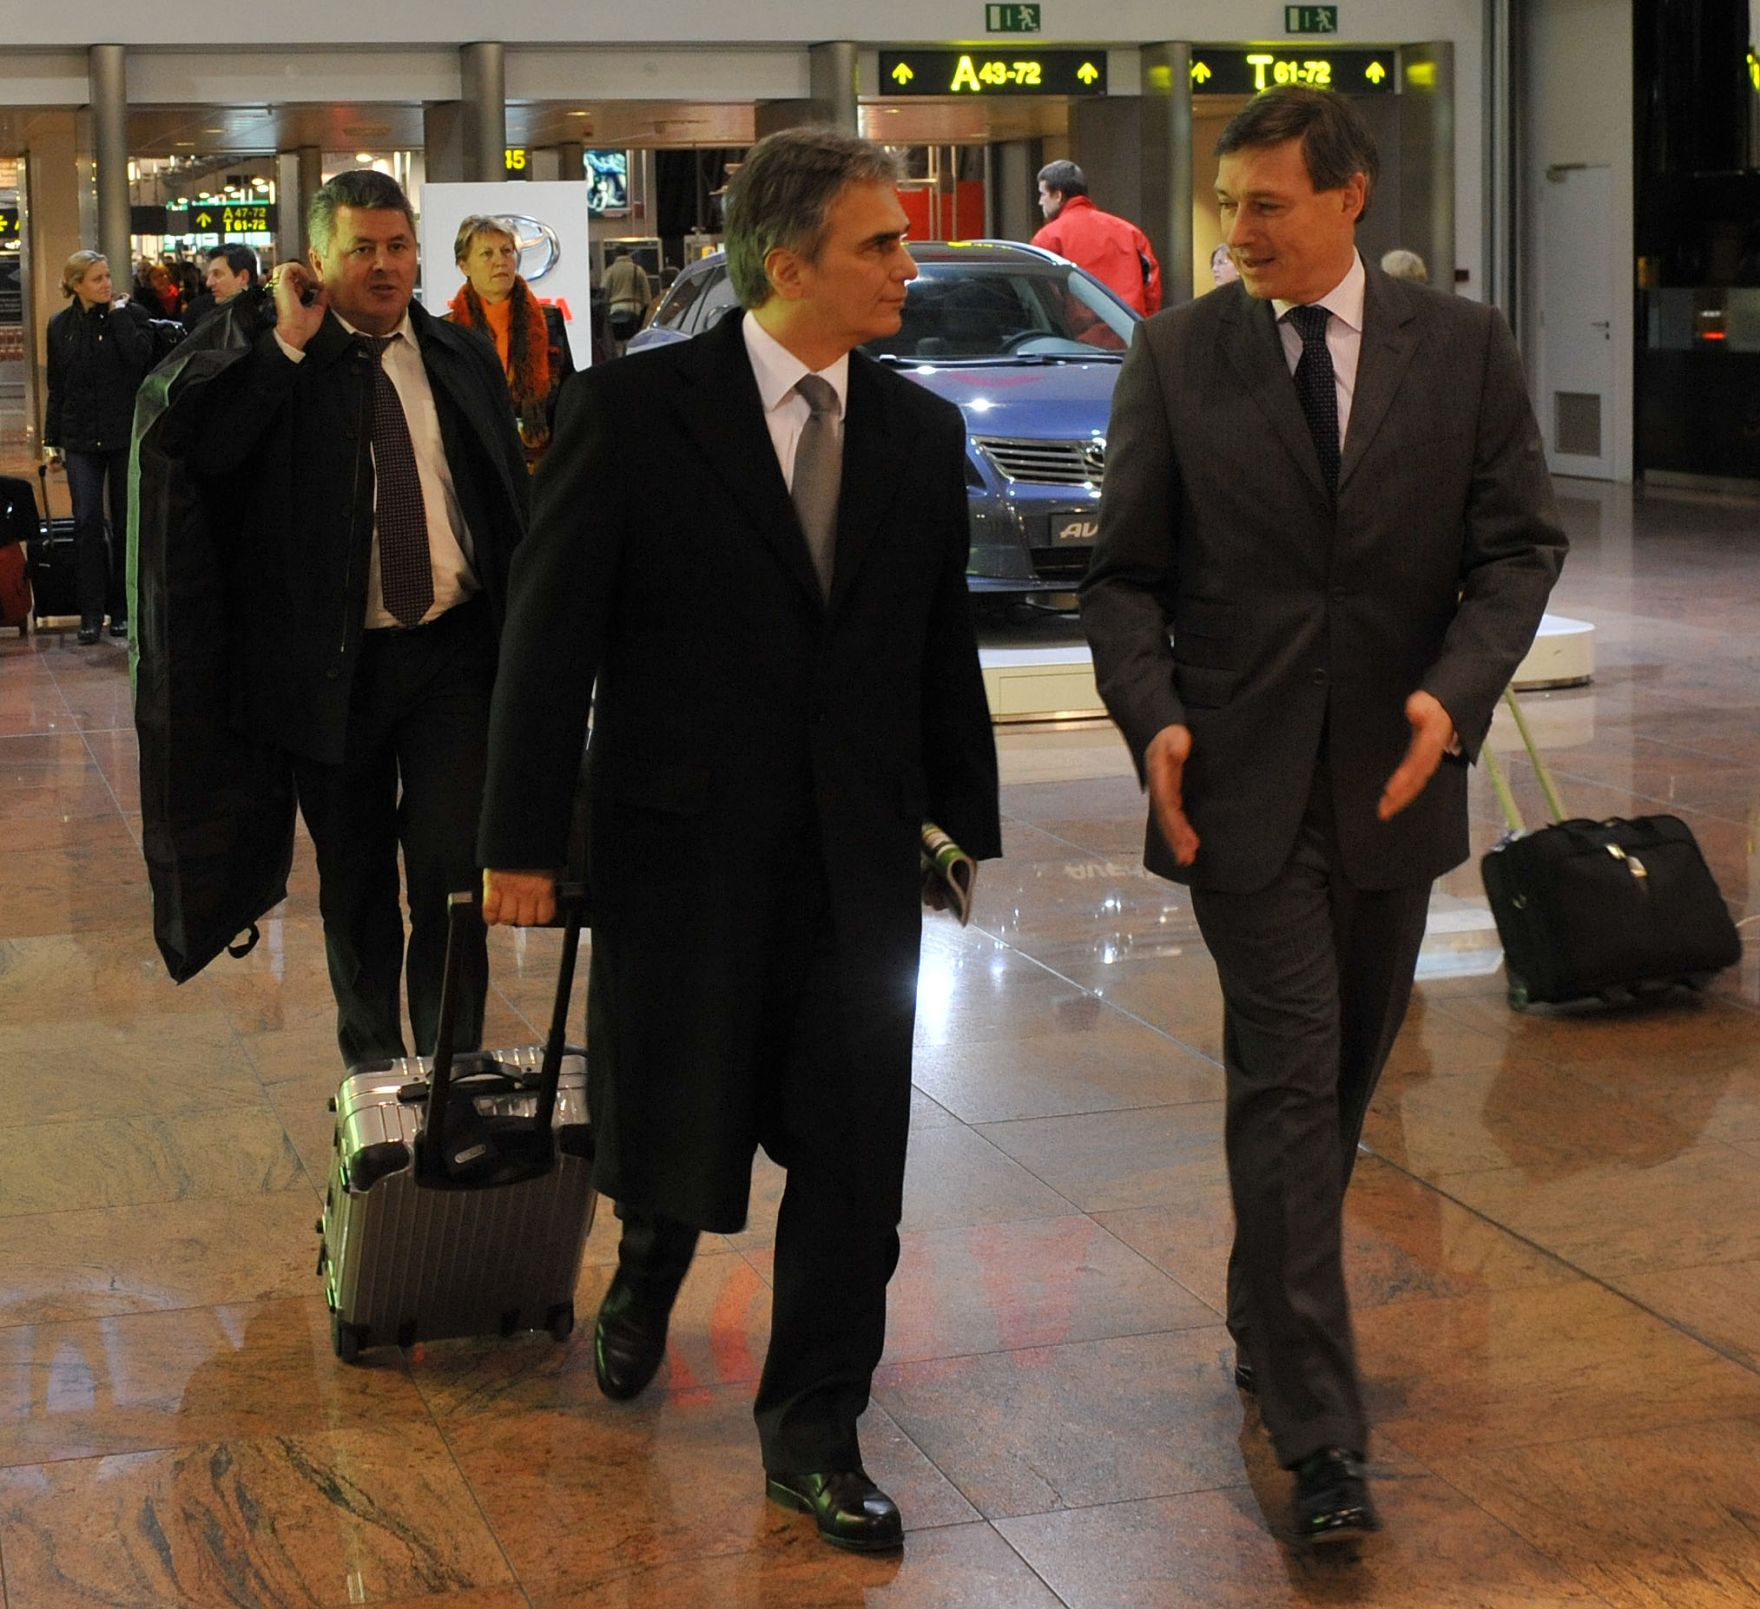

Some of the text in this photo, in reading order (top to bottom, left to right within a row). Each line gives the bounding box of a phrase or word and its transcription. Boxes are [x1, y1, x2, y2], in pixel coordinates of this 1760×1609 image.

[950, 55, 1042, 92] A 43-72
[1246, 54, 1332, 91] T 61-72
[222, 218, 234, 232] T
[223, 206, 234, 219] A
